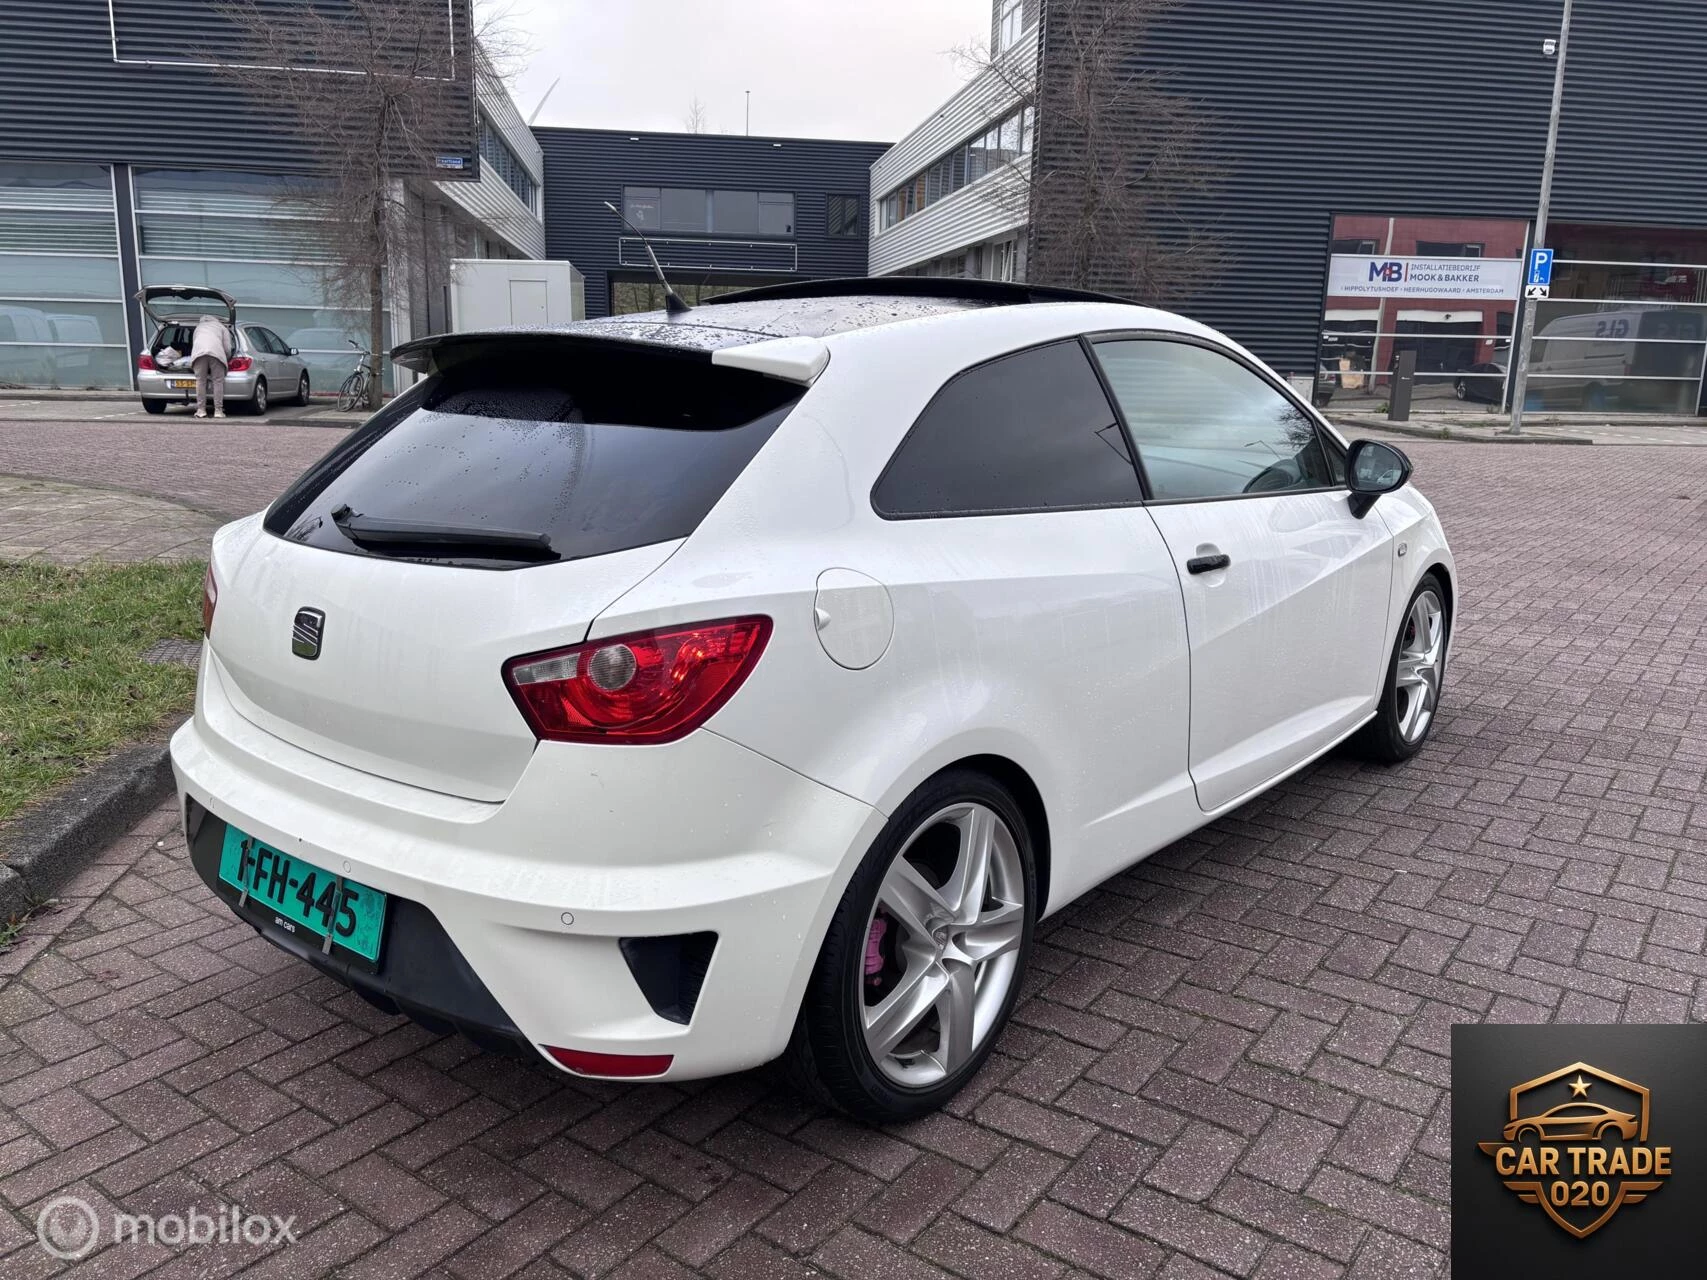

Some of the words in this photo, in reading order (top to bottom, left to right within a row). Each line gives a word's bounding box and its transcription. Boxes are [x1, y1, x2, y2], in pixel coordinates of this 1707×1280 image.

[1535, 252, 1548, 270] P
[1410, 263, 1481, 272] INSTALLATIEBEDRIJF
[1409, 273, 1436, 281] MOOK
[1444, 274, 1480, 282] BAKKER
[237, 840, 358, 937] 1-FH-445
[283, 921, 296, 933] cars
